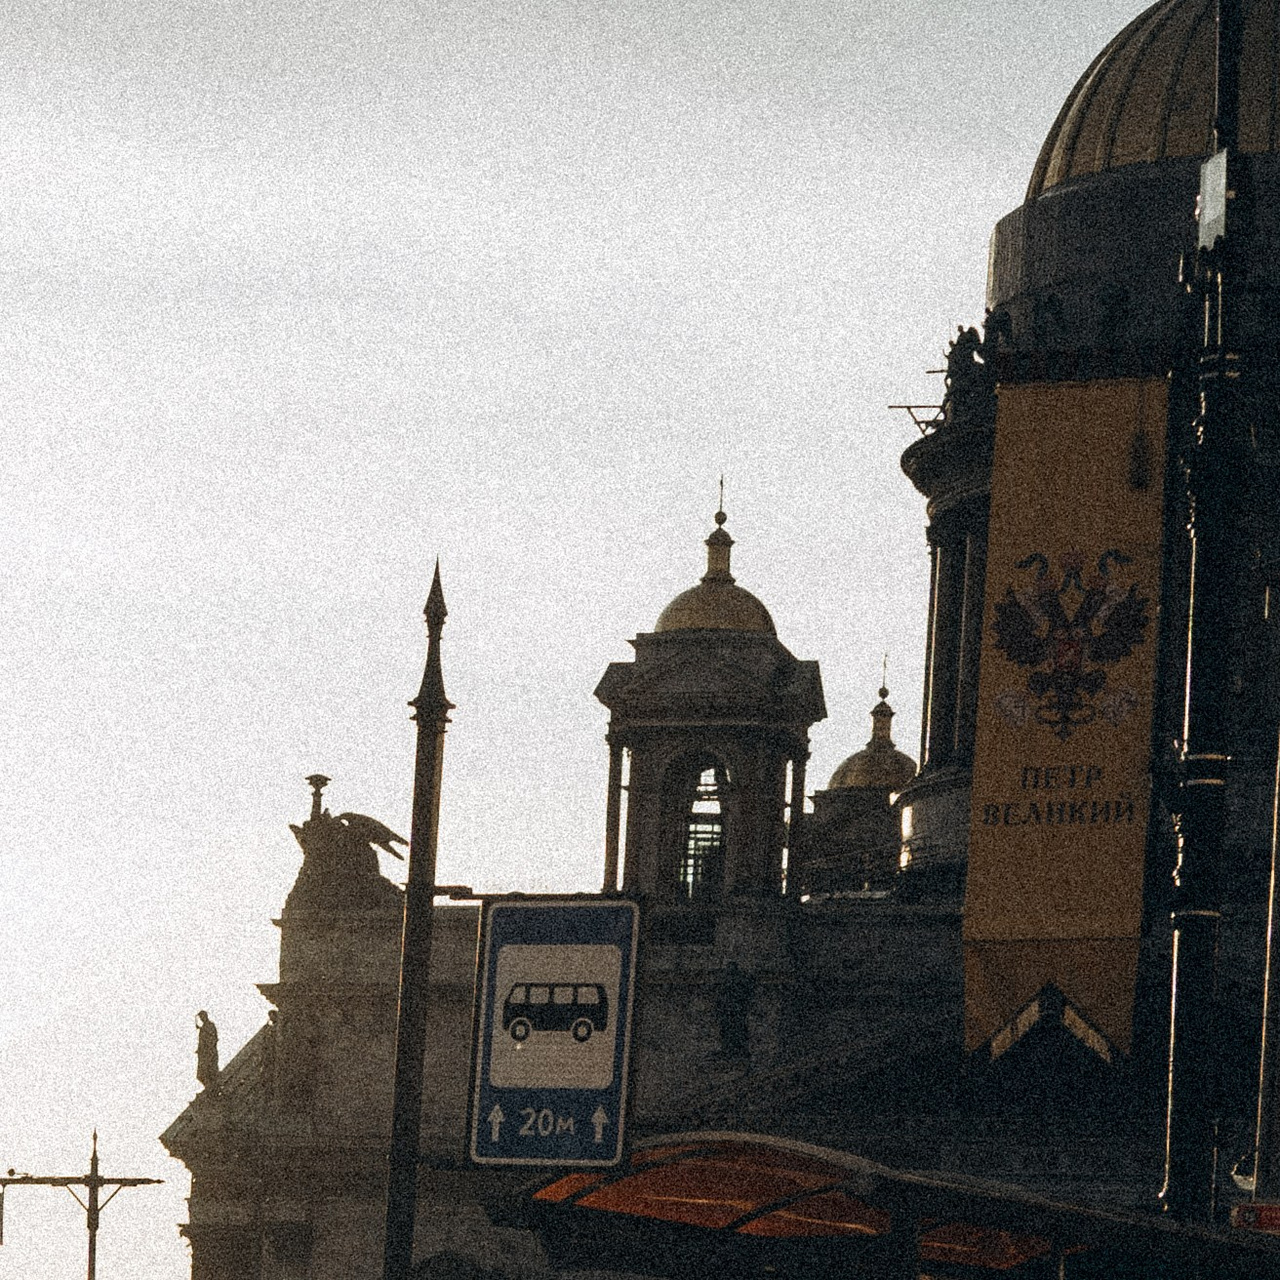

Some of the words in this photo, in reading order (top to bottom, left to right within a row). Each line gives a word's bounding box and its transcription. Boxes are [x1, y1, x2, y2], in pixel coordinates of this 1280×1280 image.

[1020, 764, 1103, 789] ПЕТР
[982, 792, 1135, 827] ВЕЛИКИЙ
[519, 1107, 575, 1137] 20м
